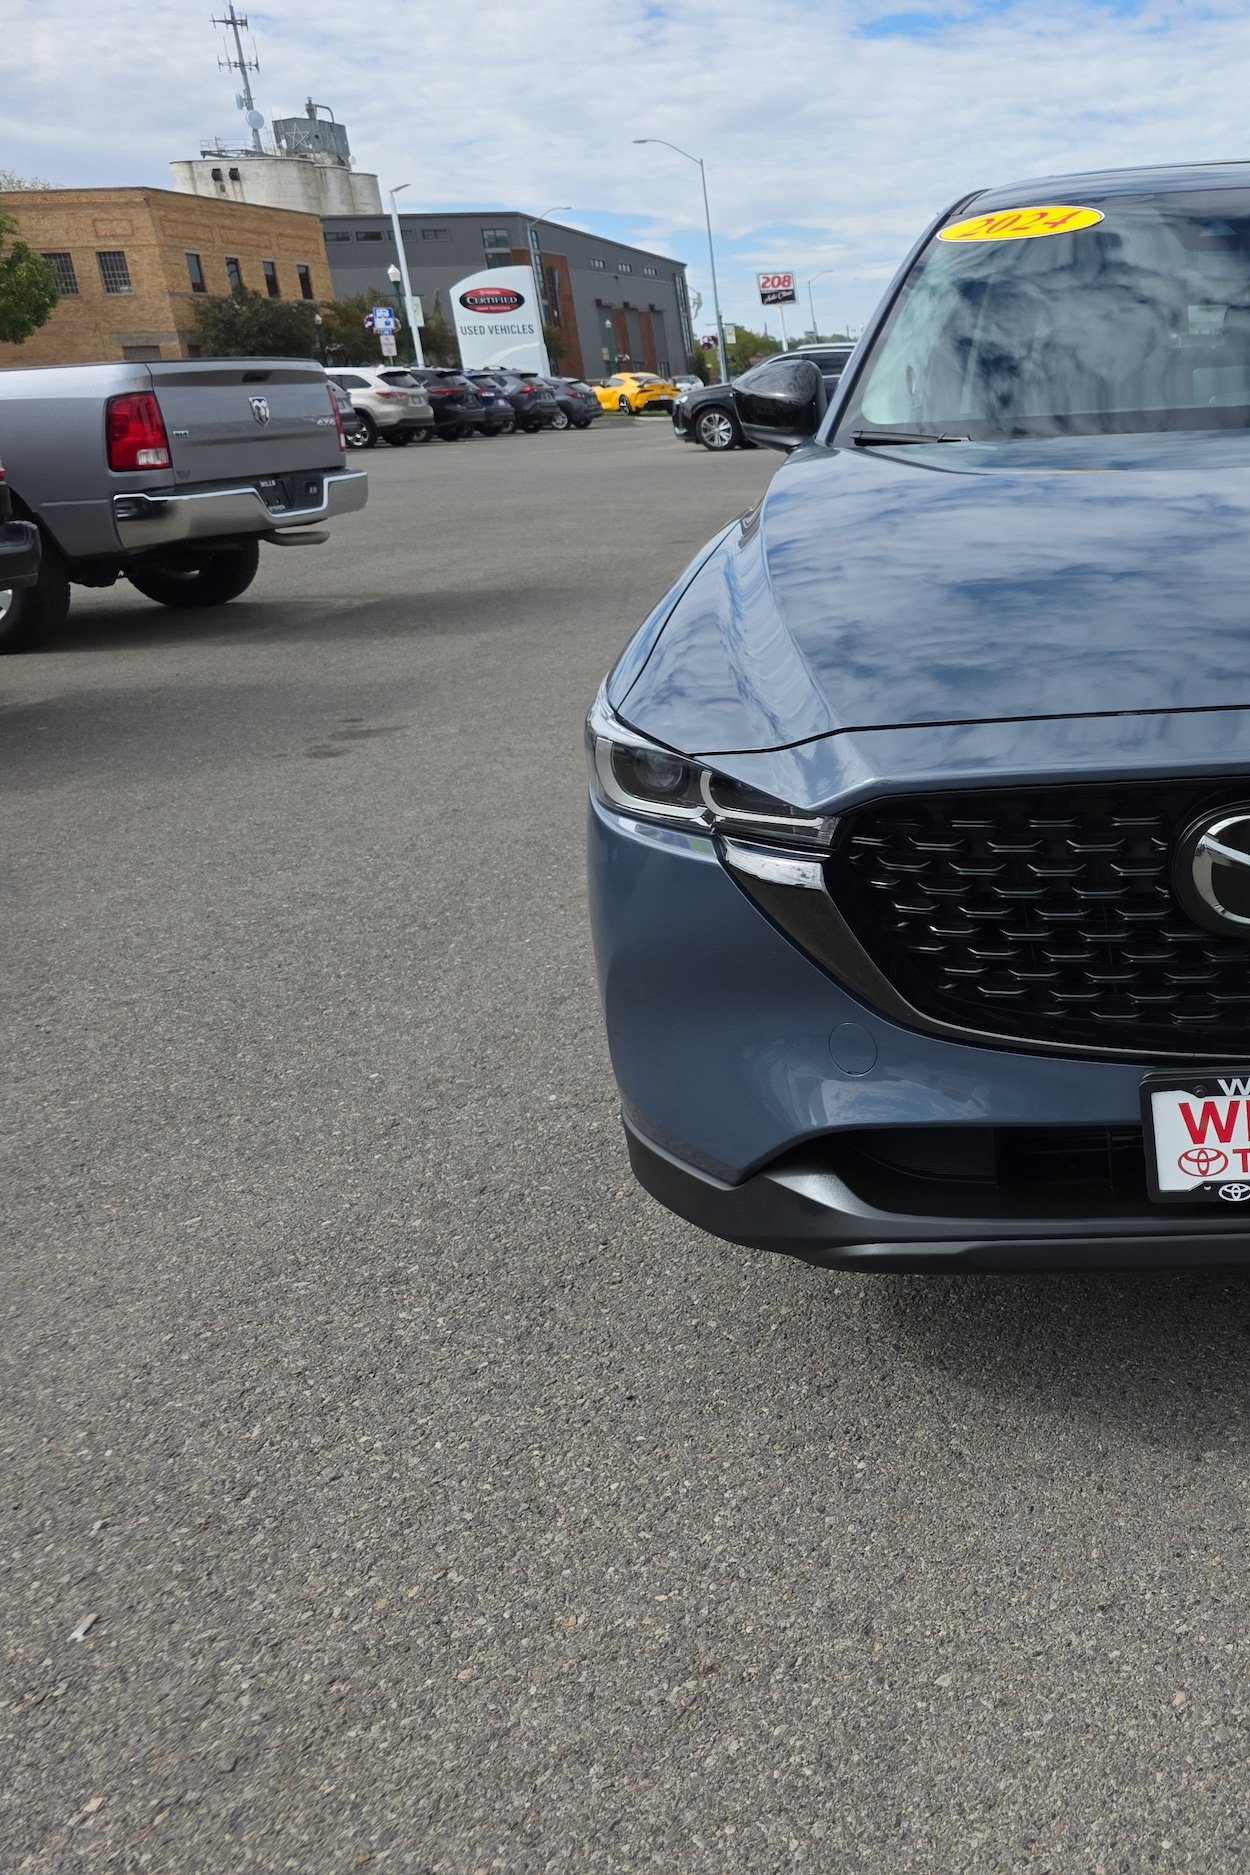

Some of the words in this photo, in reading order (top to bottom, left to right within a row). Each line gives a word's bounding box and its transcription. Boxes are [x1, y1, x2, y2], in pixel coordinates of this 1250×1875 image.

[958, 210, 1082, 237] 2024
[762, 275, 791, 288] 208
[461, 326, 485, 335] USED
[488, 325, 534, 335] VEHICLES
